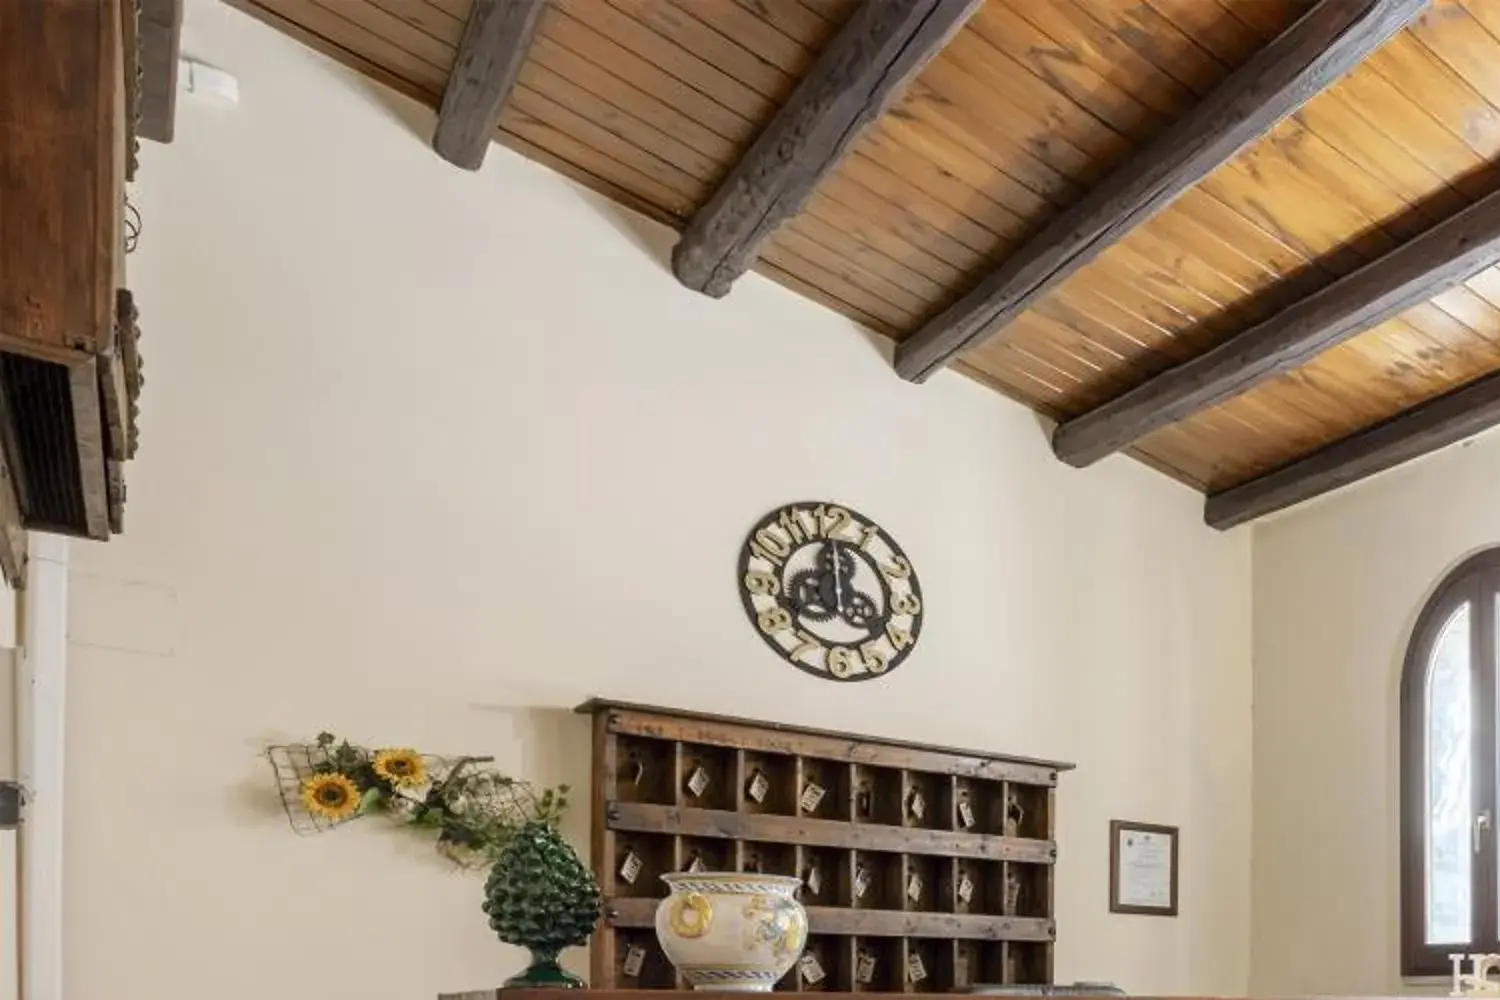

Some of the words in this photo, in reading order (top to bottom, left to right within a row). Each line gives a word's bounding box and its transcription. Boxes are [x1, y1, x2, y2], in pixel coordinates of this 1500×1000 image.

[813, 504, 852, 540] 12
[750, 529, 791, 566] 10
[859, 525, 878, 551] 1
[878, 556, 910, 580] 2
[744, 572, 780, 596] 9
[890, 594, 920, 616] 3
[758, 607, 792, 635] 8
[790, 628, 821, 662] 7
[886, 622, 914, 649] 4
[828, 646, 853, 679] 6
[860, 642, 888, 673] 5
